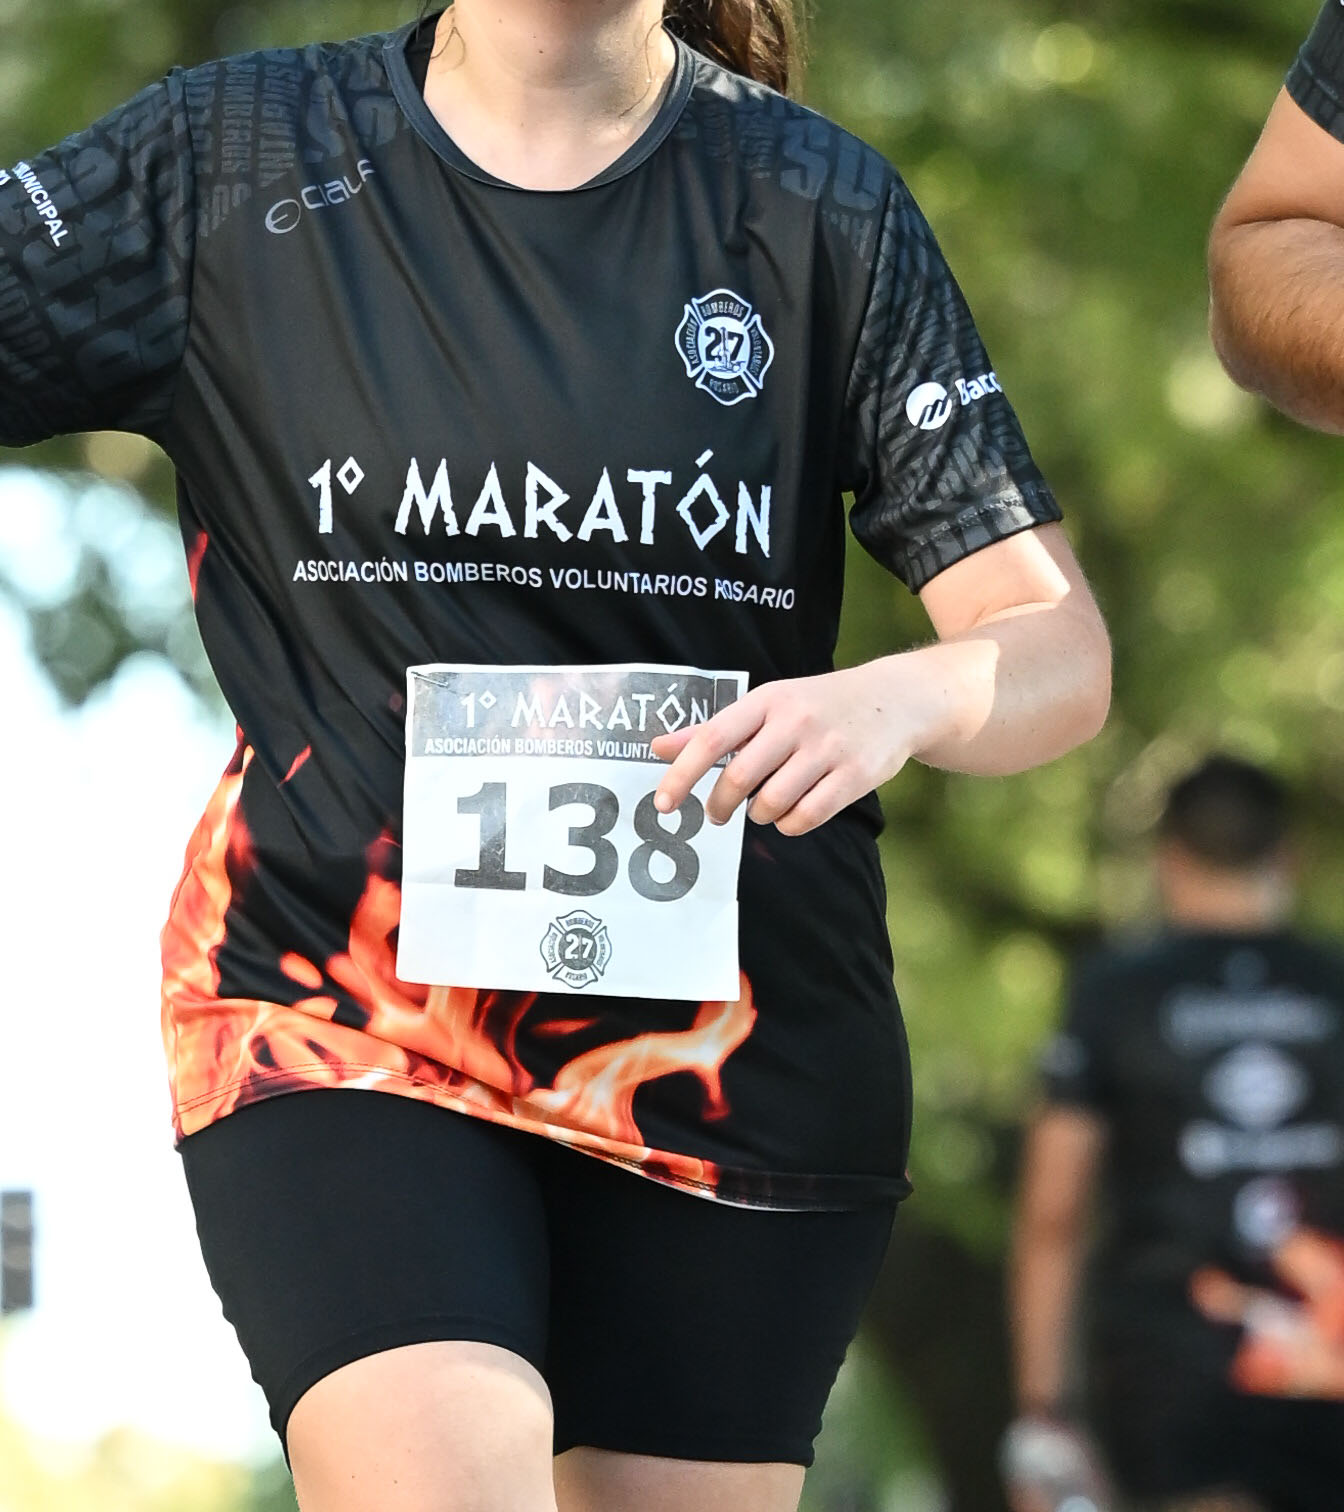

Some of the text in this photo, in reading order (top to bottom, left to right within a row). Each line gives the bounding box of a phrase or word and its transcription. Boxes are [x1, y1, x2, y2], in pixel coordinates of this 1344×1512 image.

[393, 448, 772, 559] MARATÓN
[292, 556, 796, 611] ASOCIACIÓN BOMBEROS VOLUNTARIOS ROSARIO
[510, 681, 709, 734] MARATÓN
[424, 734, 511, 756] ASOCIACIÓN
[514, 738, 593, 757] BOMBEROS
[453, 781, 706, 903] 138
